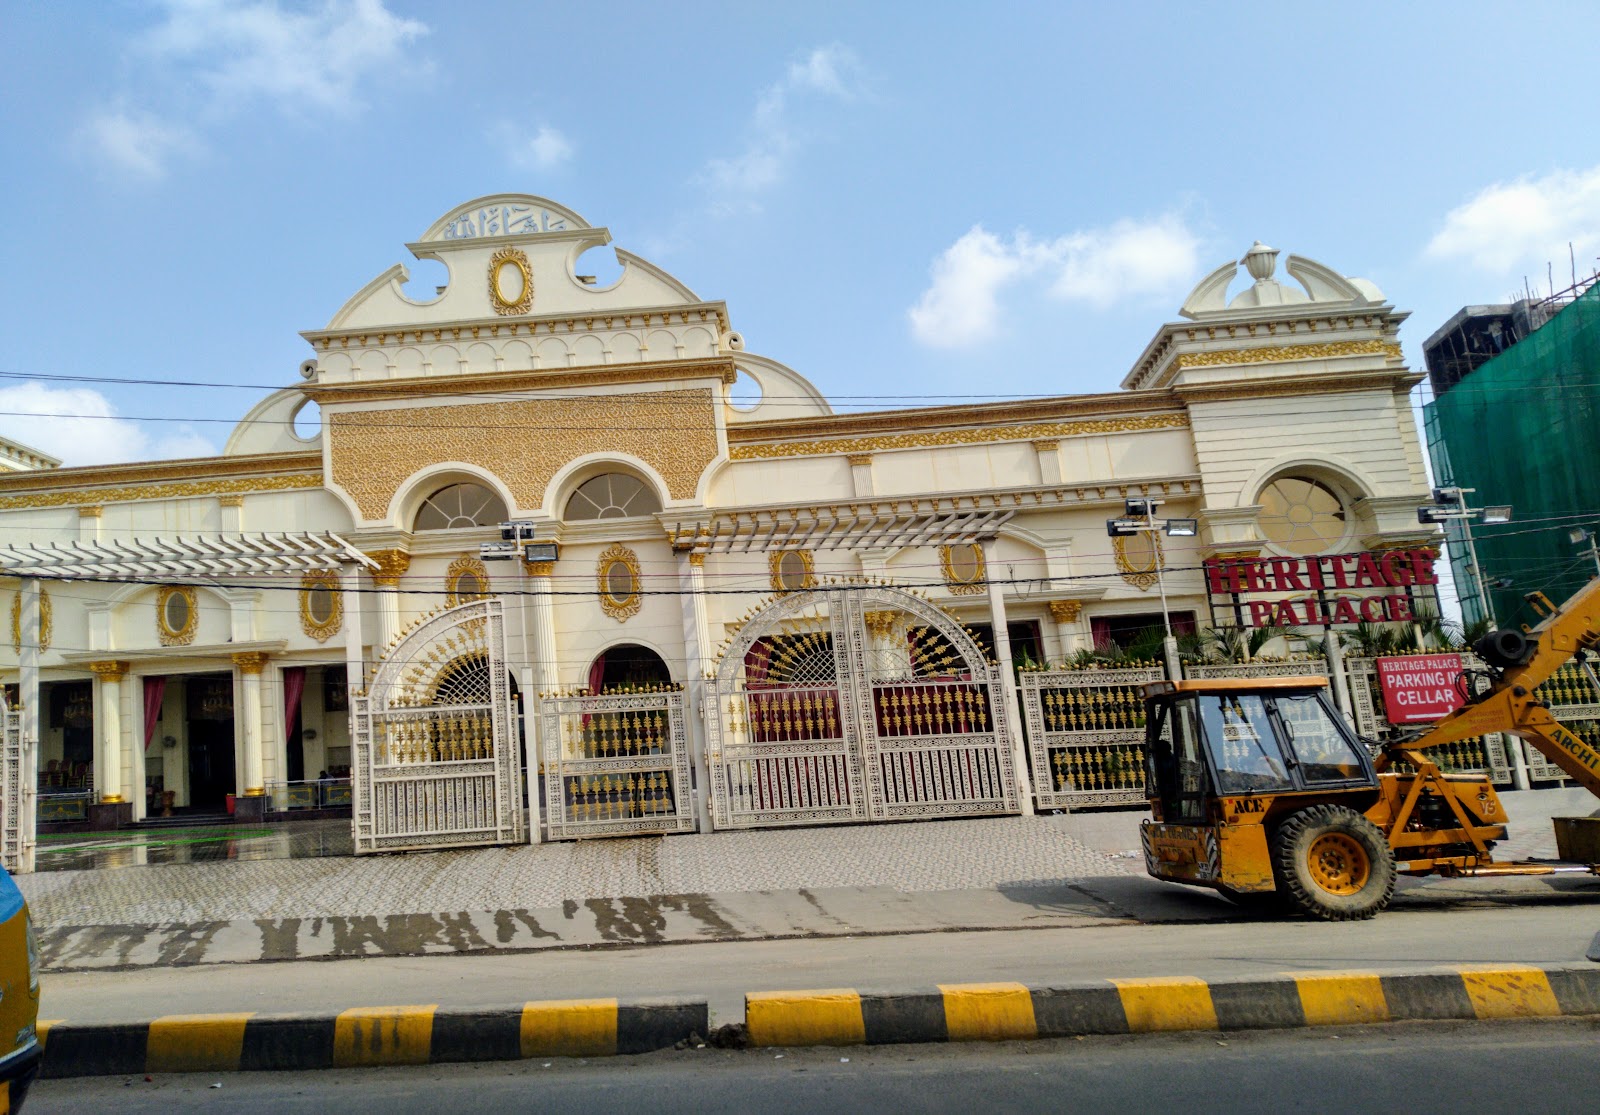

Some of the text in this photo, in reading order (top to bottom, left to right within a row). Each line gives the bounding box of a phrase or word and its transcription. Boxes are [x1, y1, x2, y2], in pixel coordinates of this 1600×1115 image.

[1205, 549, 1439, 594] HERITAGE
[1250, 594, 1413, 627] PALACE
[1382, 658, 1459, 672] HERITAGE PALACE
[1386, 671, 1445, 688] PARKING
[1396, 688, 1455, 705] CELLAR
[1550, 729, 1600, 769] ARCHI
[1234, 799, 1265, 814] ACE
